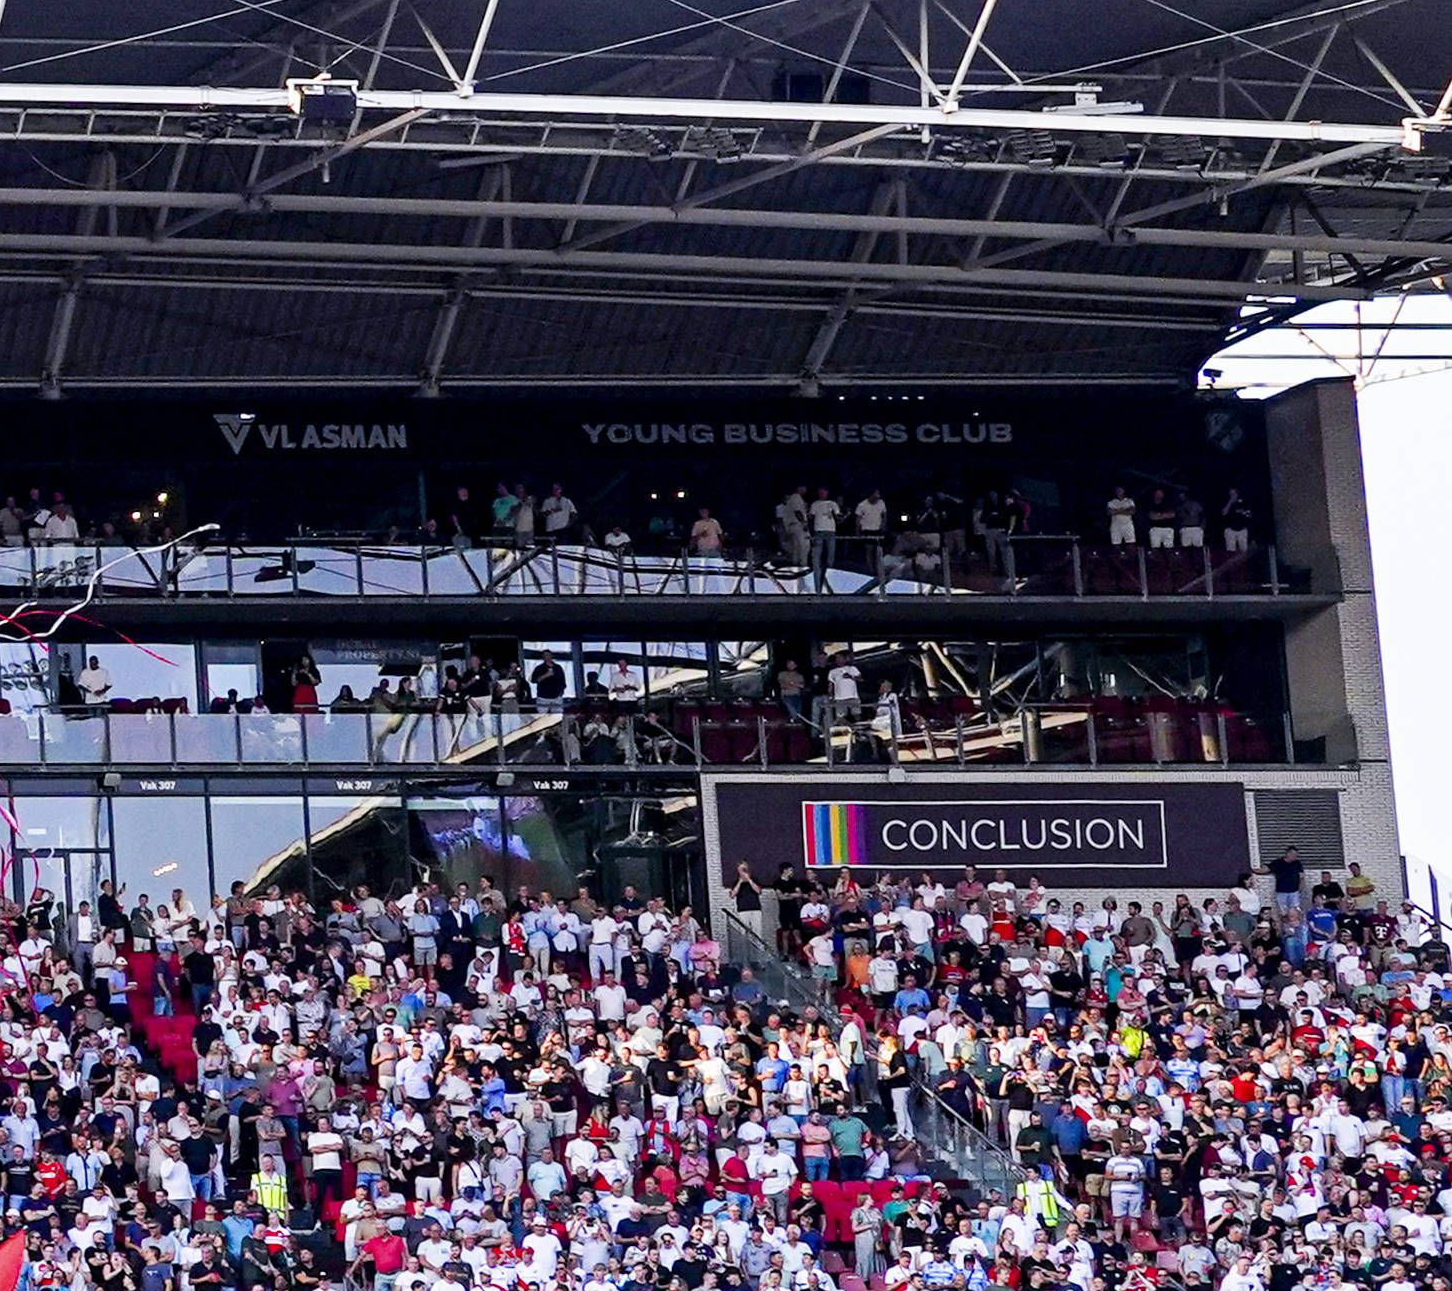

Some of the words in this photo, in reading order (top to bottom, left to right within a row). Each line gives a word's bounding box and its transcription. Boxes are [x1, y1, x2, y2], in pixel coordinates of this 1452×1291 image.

[258, 424, 408, 449] VLASMAN
[582, 423, 715, 445] YOUNG
[723, 423, 909, 445] BUSINESS
[916, 423, 1013, 445] CLUB
[140, 781, 157, 790] Vak
[158, 781, 175, 790] 307
[336, 781, 352, 790] Vak
[354, 781, 371, 790] 307
[533, 781, 550, 790] Vak
[551, 781, 568, 790] 307
[881, 818, 1145, 851] CONCLUSION
